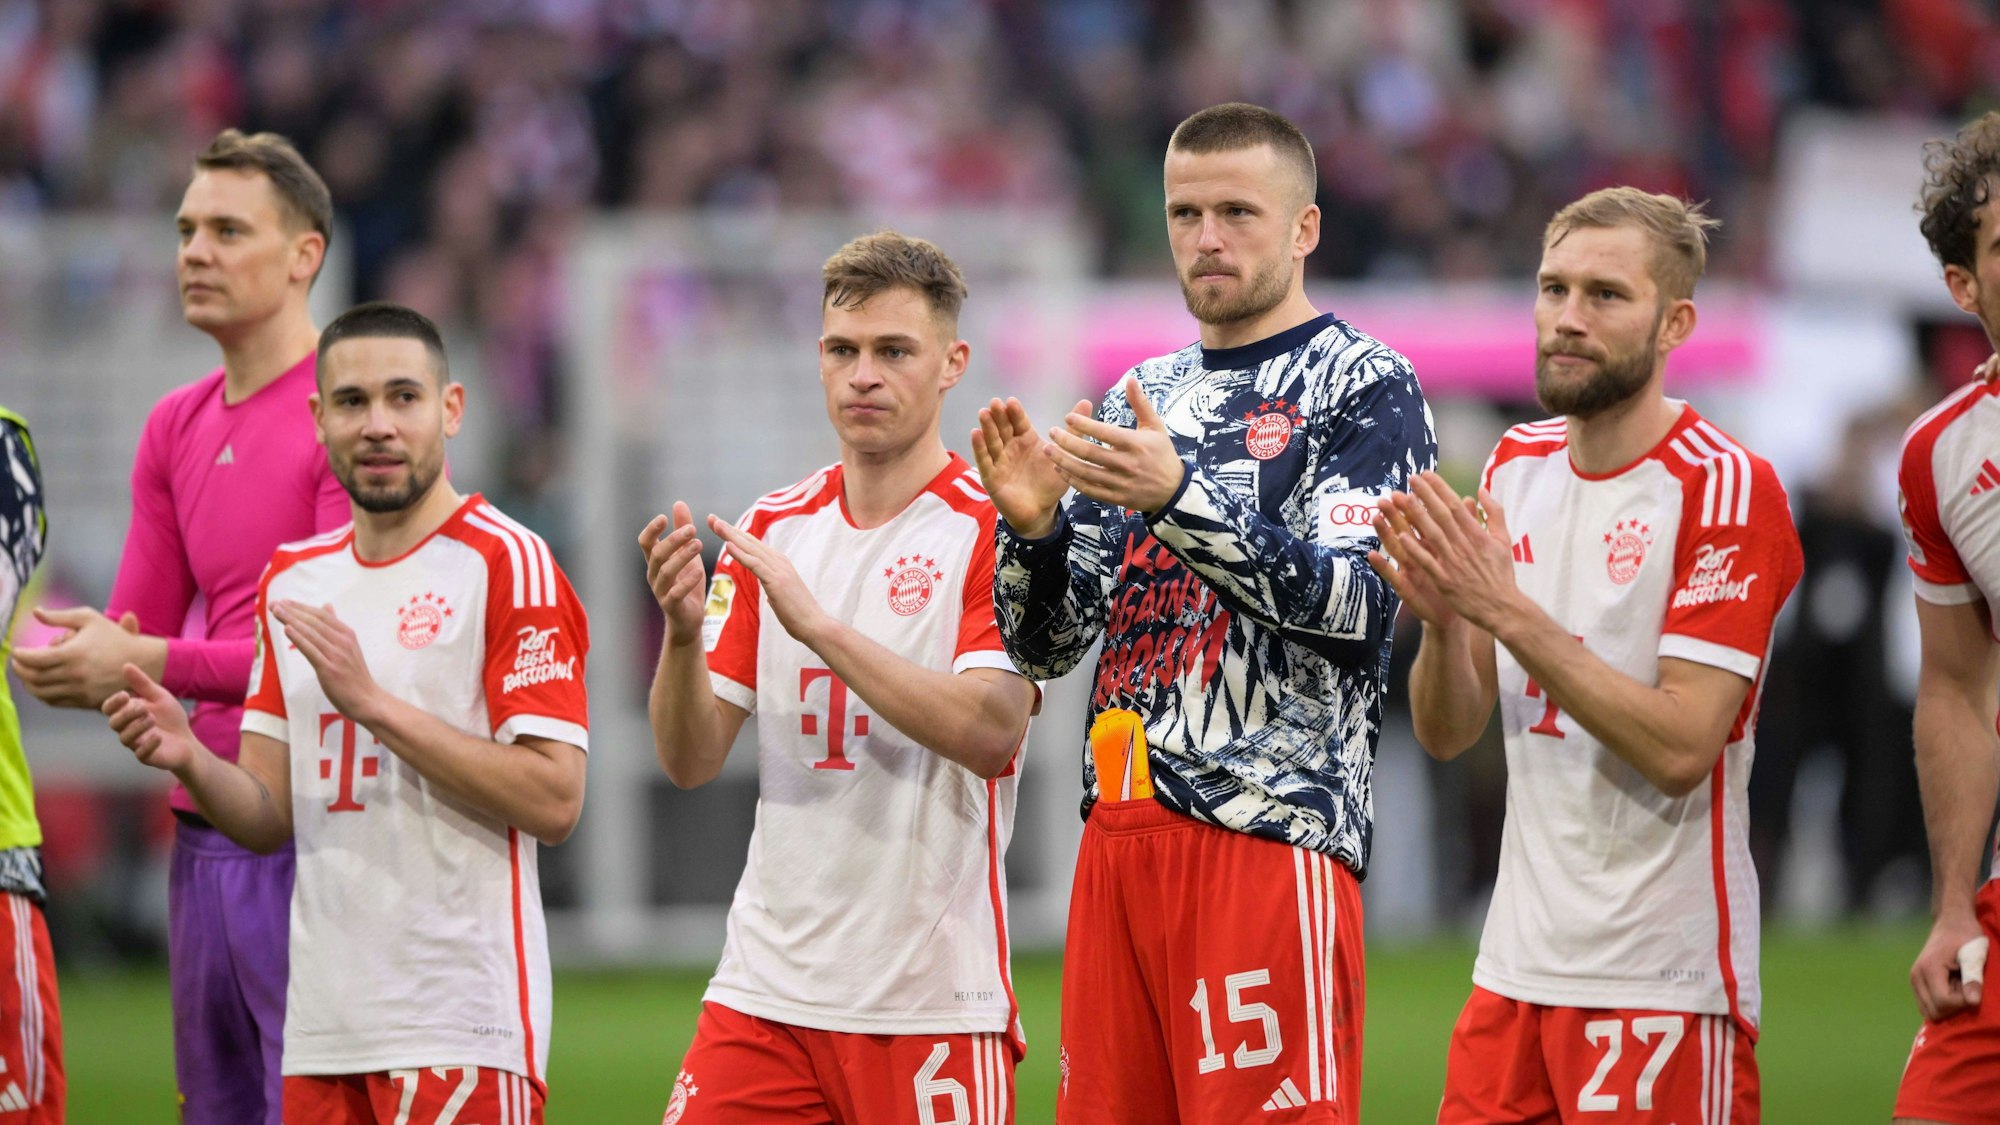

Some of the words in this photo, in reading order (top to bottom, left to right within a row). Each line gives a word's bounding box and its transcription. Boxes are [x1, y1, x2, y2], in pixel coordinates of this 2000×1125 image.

[1264, 415, 1289, 435] BAYERN
[903, 570, 929, 590] BAYERN
[1695, 543, 1740, 572] ROT
[514, 639, 556, 671] GEGEN
[516, 625, 560, 656] ROT
[1093, 608, 1231, 710] RACISM
[502, 655, 576, 695] RASSISMUS
[800, 667, 859, 771] T
[319, 712, 380, 813] T
[1189, 968, 1284, 1075] 15
[913, 1041, 972, 1125] 6
[1577, 1015, 1685, 1112] 27
